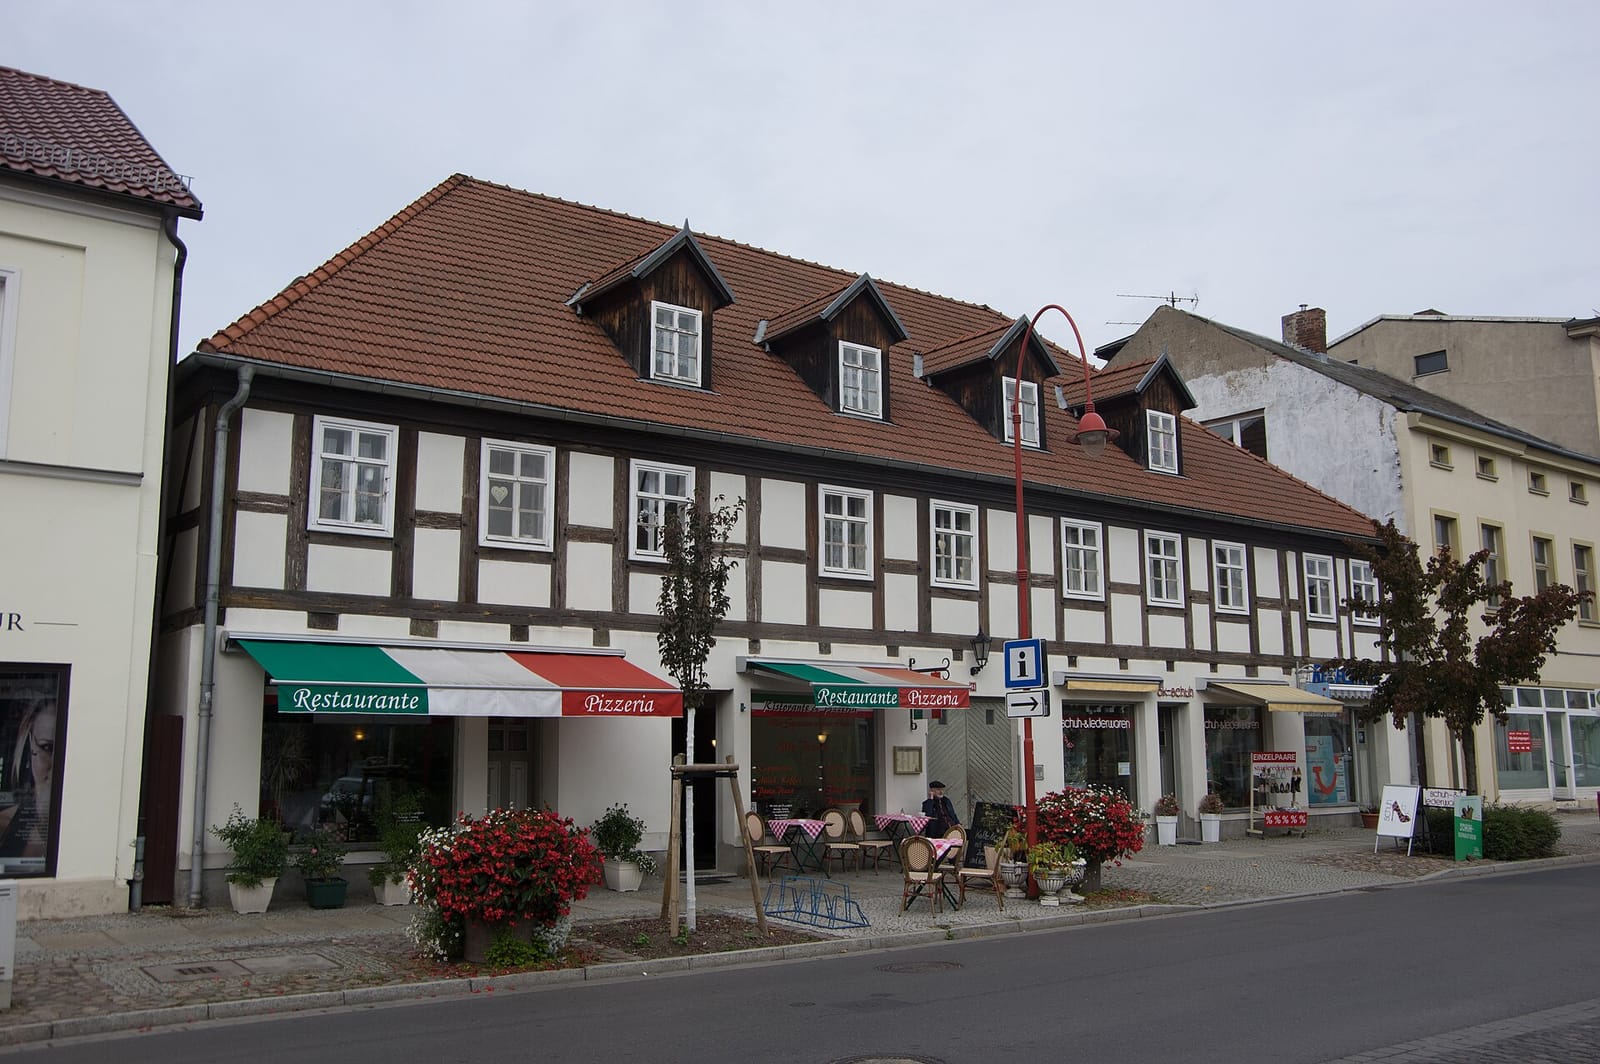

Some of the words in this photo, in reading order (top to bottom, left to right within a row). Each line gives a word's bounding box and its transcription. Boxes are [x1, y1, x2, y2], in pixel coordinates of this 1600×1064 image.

[293, 688, 419, 712] Restaurante
[584, 693, 655, 713] Pizzeria
[817, 687, 898, 706] Restaurante
[907, 689, 959, 706] Pizzeria
[1253, 753, 1296, 761] EINZELPAARE
